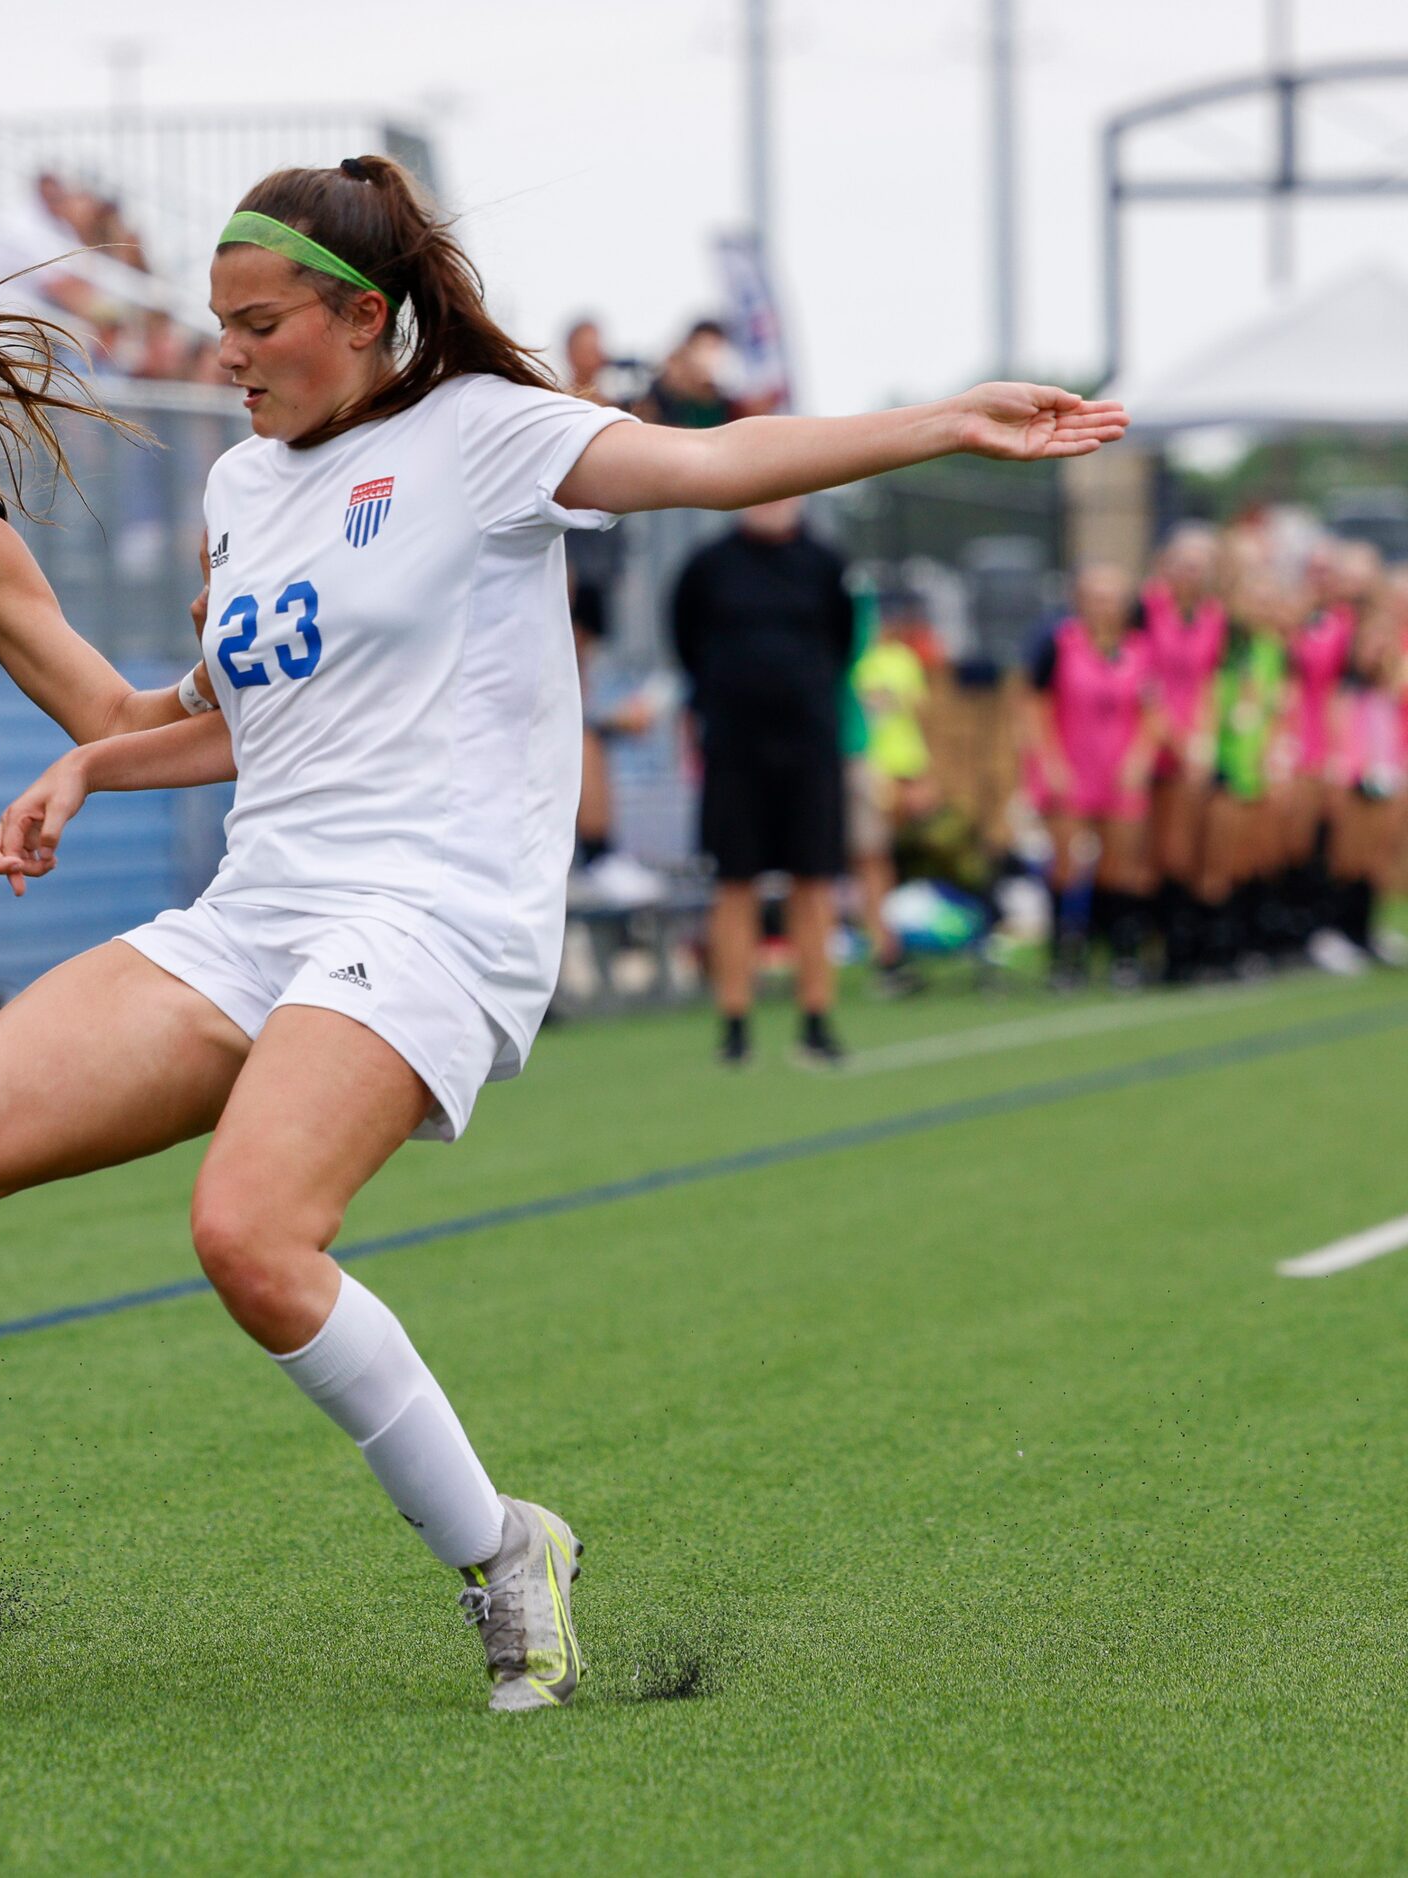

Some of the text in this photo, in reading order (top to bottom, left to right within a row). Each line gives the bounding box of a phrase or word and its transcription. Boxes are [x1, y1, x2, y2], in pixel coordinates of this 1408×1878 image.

[350, 486, 391, 504] SOCCER
[216, 580, 323, 690] 23
[328, 971, 373, 991] adidas
